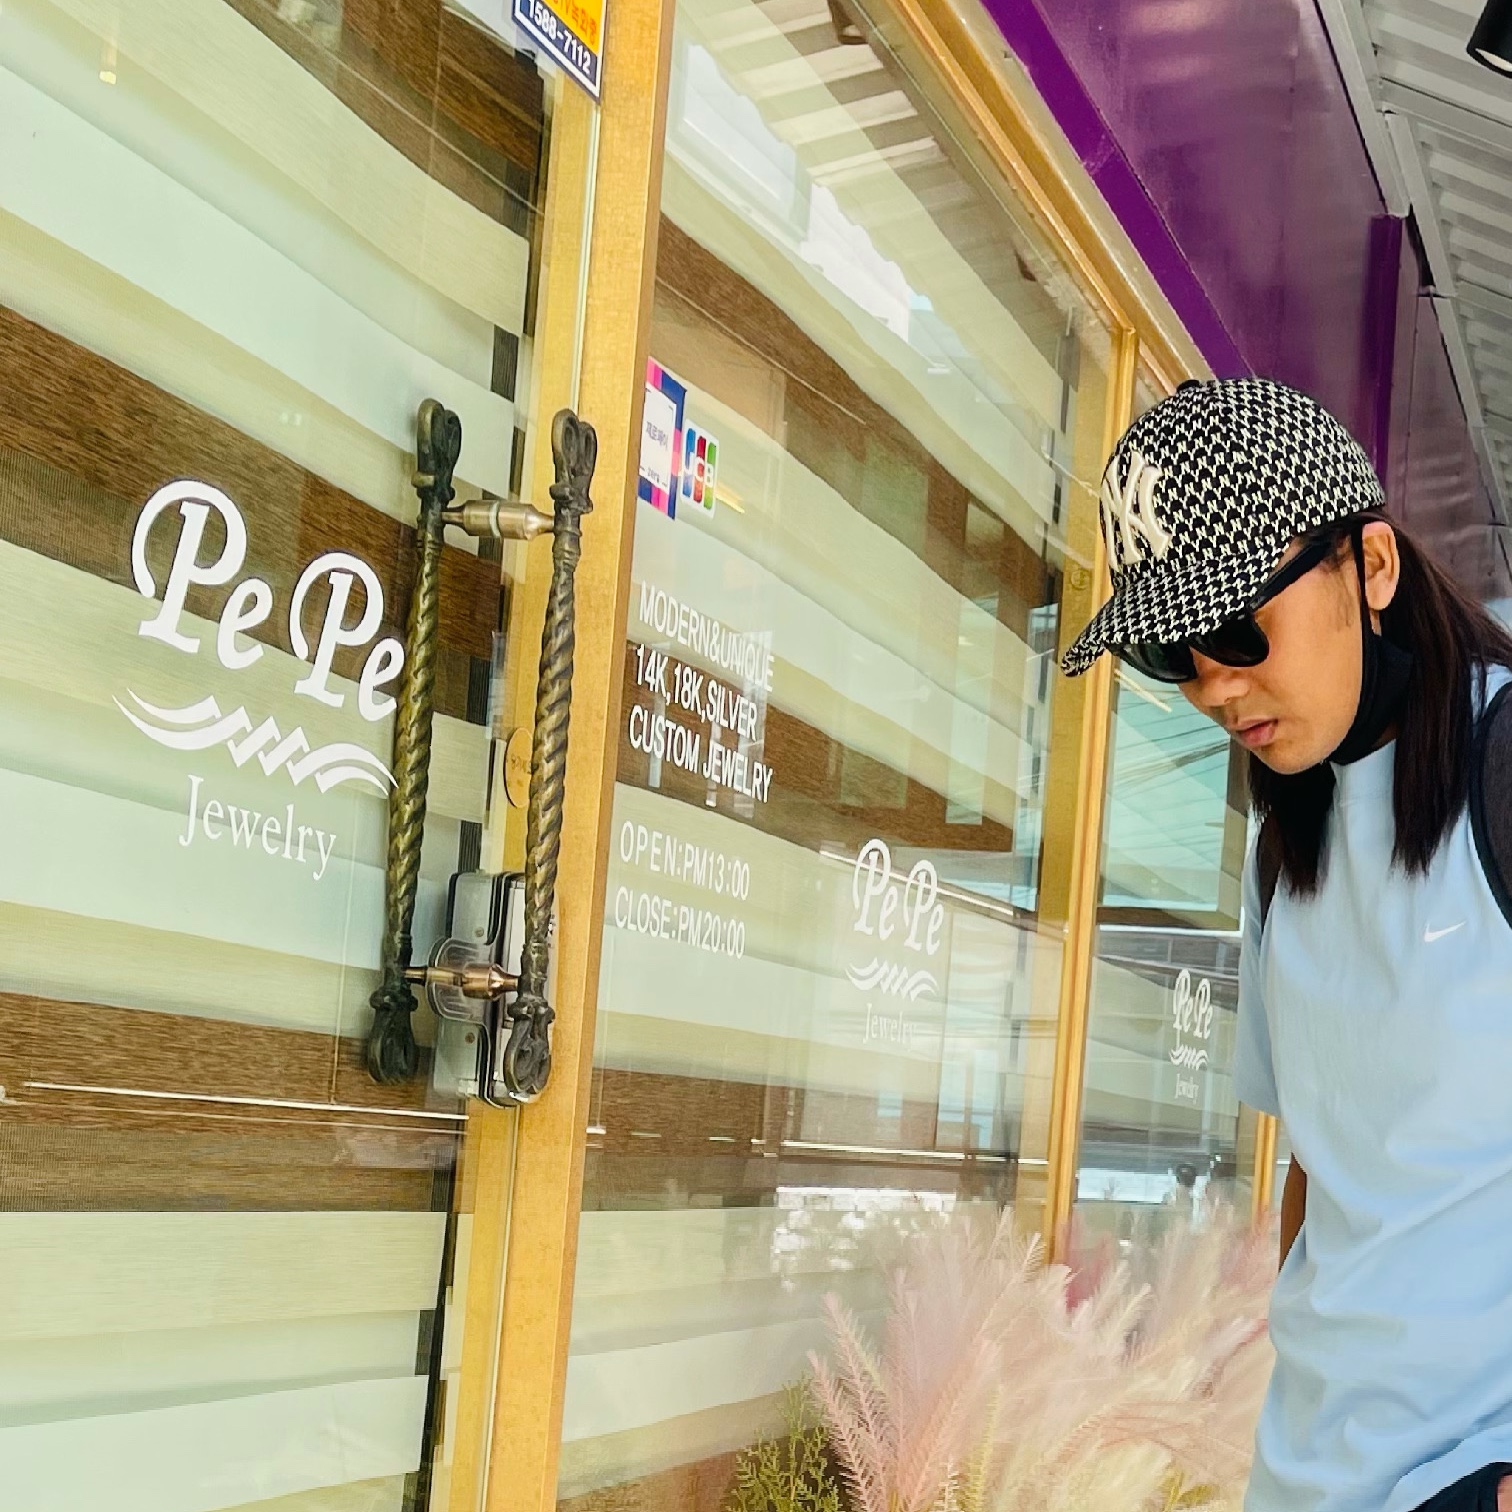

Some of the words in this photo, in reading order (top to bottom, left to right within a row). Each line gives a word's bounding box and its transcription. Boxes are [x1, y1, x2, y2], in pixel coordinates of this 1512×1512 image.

[529, 0, 591, 75] 1588-7112
[639, 581, 775, 692] MODERN&UNIQUE
[629, 705, 701, 774] CUSTOM
[703, 740, 773, 804] JEWELRY
[179, 774, 337, 881] Jewelry
[862, 1002, 916, 1053] Jewelry
